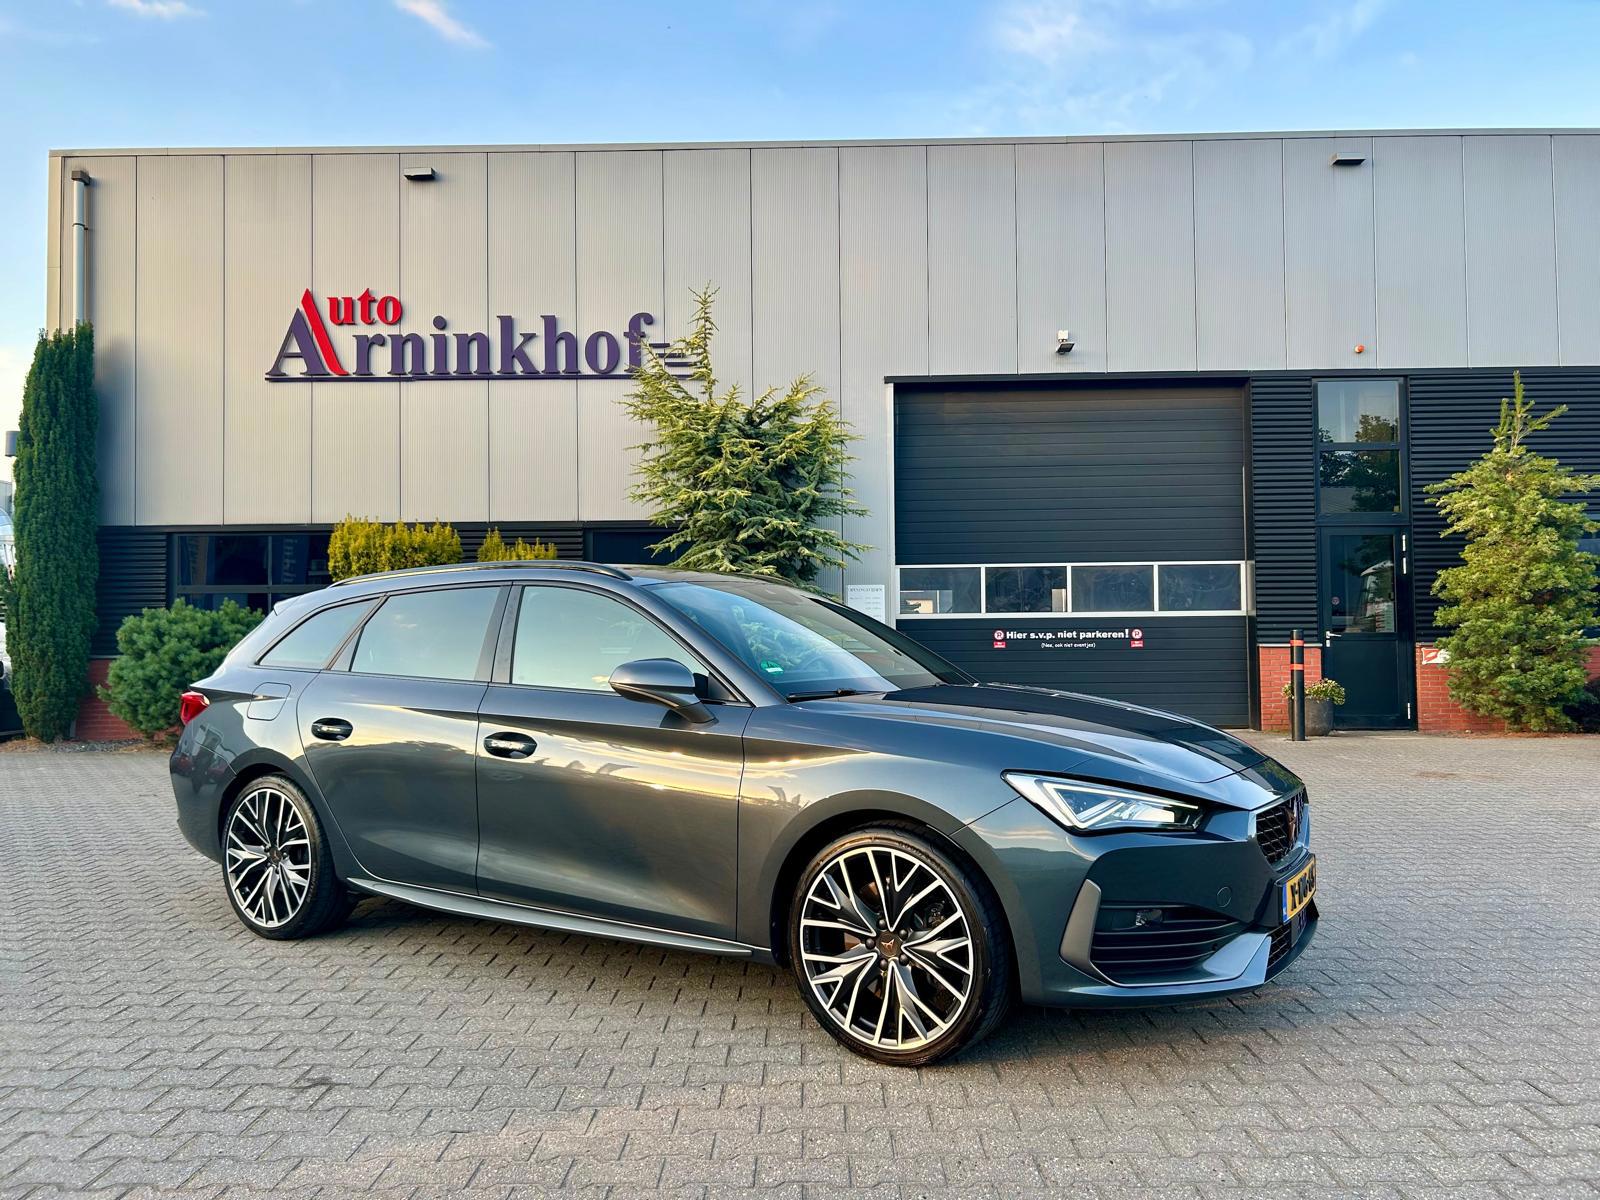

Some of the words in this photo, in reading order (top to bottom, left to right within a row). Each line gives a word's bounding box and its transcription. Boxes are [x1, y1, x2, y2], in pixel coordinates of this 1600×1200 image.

[265, 308, 653, 376] Arninkhof
[1006, 630, 1028, 639] Hier
[1029, 632, 1056, 640] s.v.p.
[1057, 630, 1077, 639] niet
[1079, 628, 1129, 640] parkeren!
